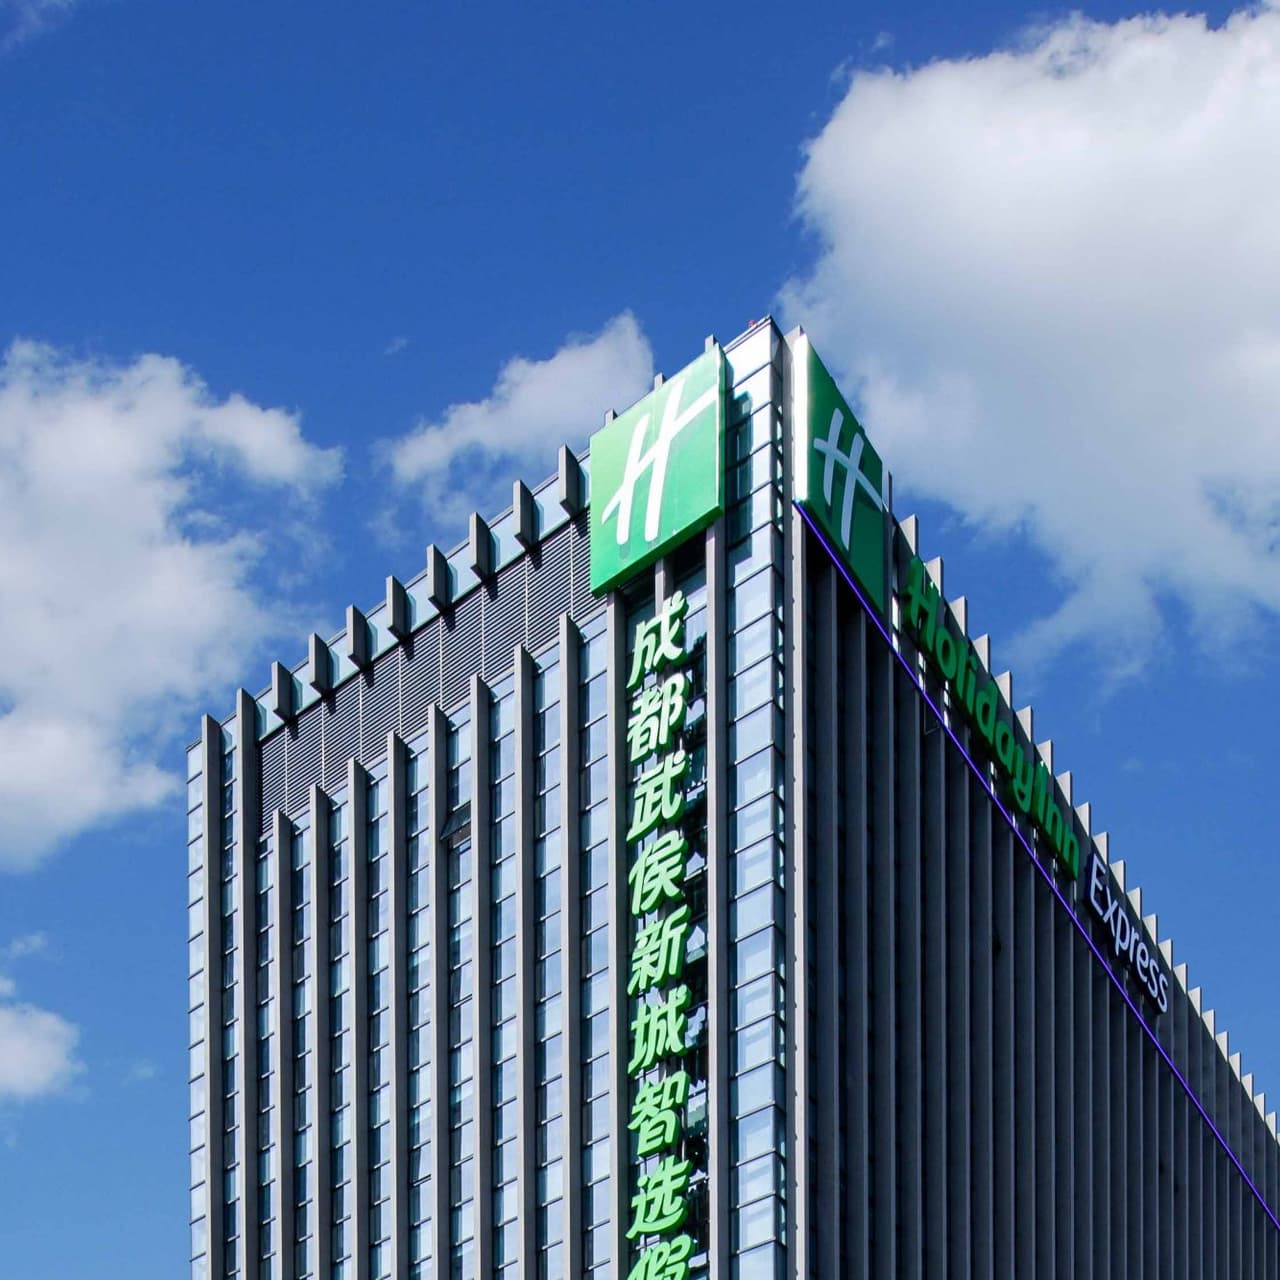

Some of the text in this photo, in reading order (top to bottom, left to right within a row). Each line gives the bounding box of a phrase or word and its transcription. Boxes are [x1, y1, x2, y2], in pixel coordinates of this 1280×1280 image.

[903, 555, 1170, 1014] Holiday Inn Express
